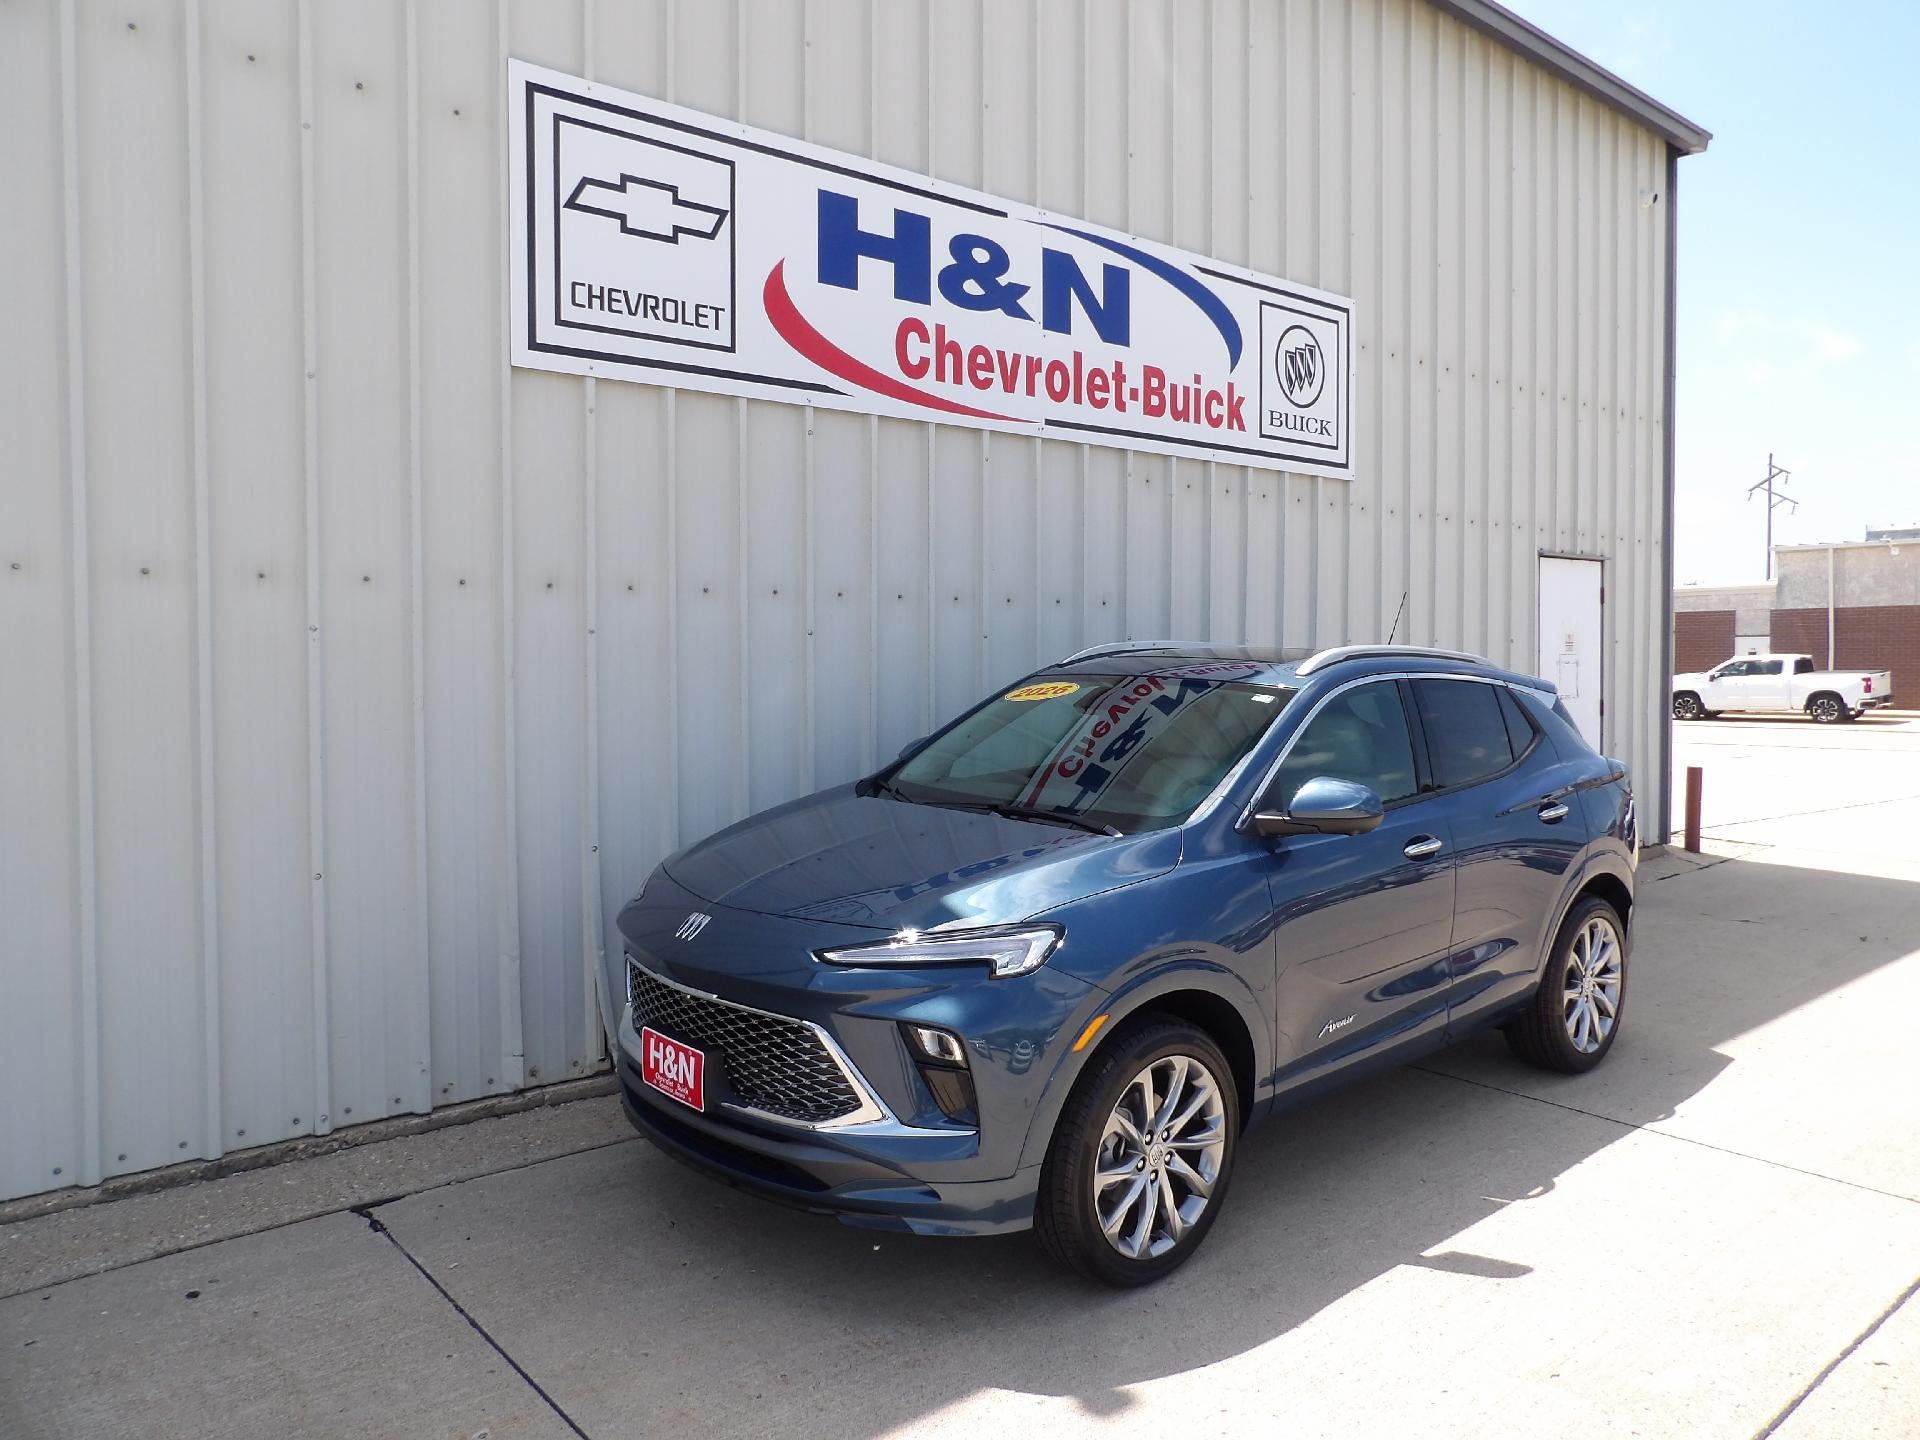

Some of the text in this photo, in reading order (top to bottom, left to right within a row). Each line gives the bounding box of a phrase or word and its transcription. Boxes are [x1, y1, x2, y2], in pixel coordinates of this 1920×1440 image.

[817, 190, 1130, 346] H&N
[571, 281, 726, 331] CHEVROLET
[896, 318, 1246, 431] Chevrolet-Buick
[1268, 409, 1332, 437] BUICK
[1010, 684, 1073, 698] 2026
[649, 1037, 696, 1090] H&N
